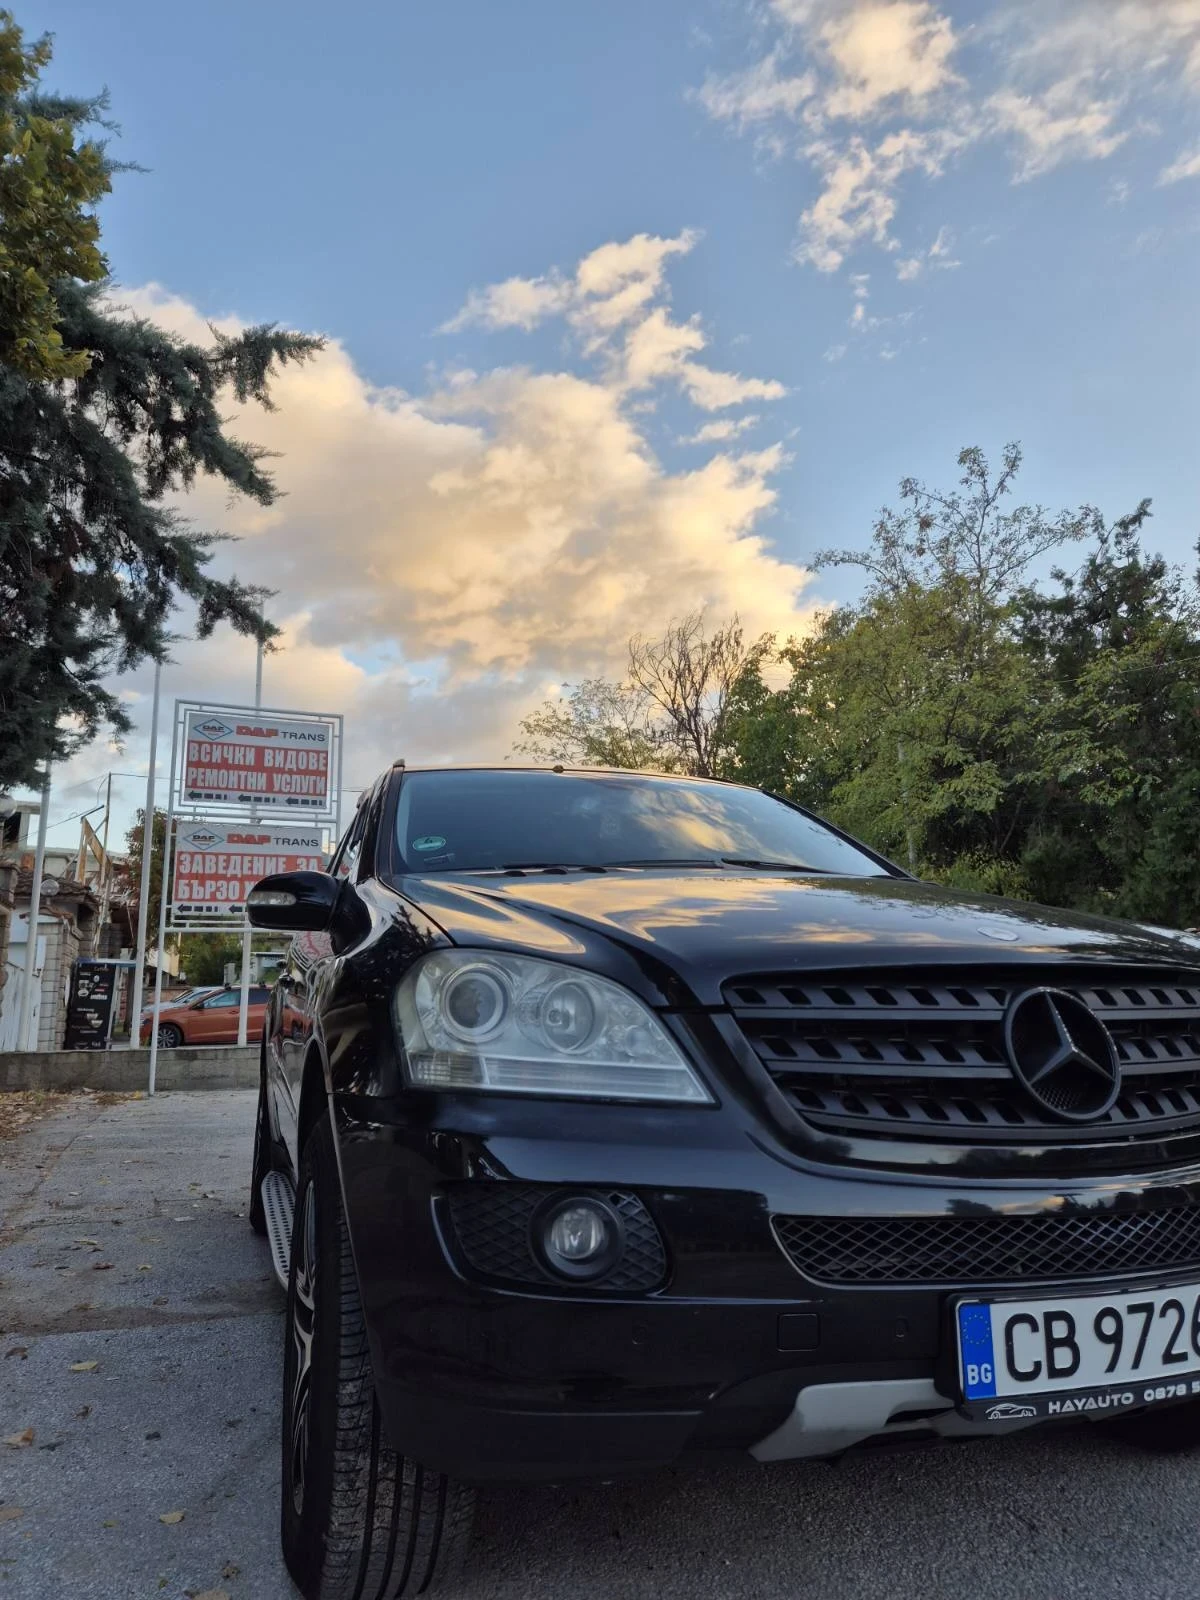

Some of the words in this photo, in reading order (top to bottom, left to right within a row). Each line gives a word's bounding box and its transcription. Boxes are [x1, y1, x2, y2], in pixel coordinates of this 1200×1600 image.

[281, 731, 326, 742] TRANS
[188, 743, 256, 766] ВСИЧКИ
[264, 748, 327, 772] ВИДОВЕ
[187, 768, 267, 791] РЕМОНТНИ
[273, 773, 326, 795] УСЛУГИ
[274, 838, 319, 847] TRANS
[179, 854, 287, 877] ЗАВЕДЕНИЕ
[296, 857, 319, 872] ЗА
[177, 879, 240, 901] БЪРЗО
[1004, 1310, 1081, 1382] CB
[967, 1363, 993, 1385] BG
[1048, 1392, 1134, 1414] HAYAUTO
[1143, 1384, 1187, 1402] 0878
